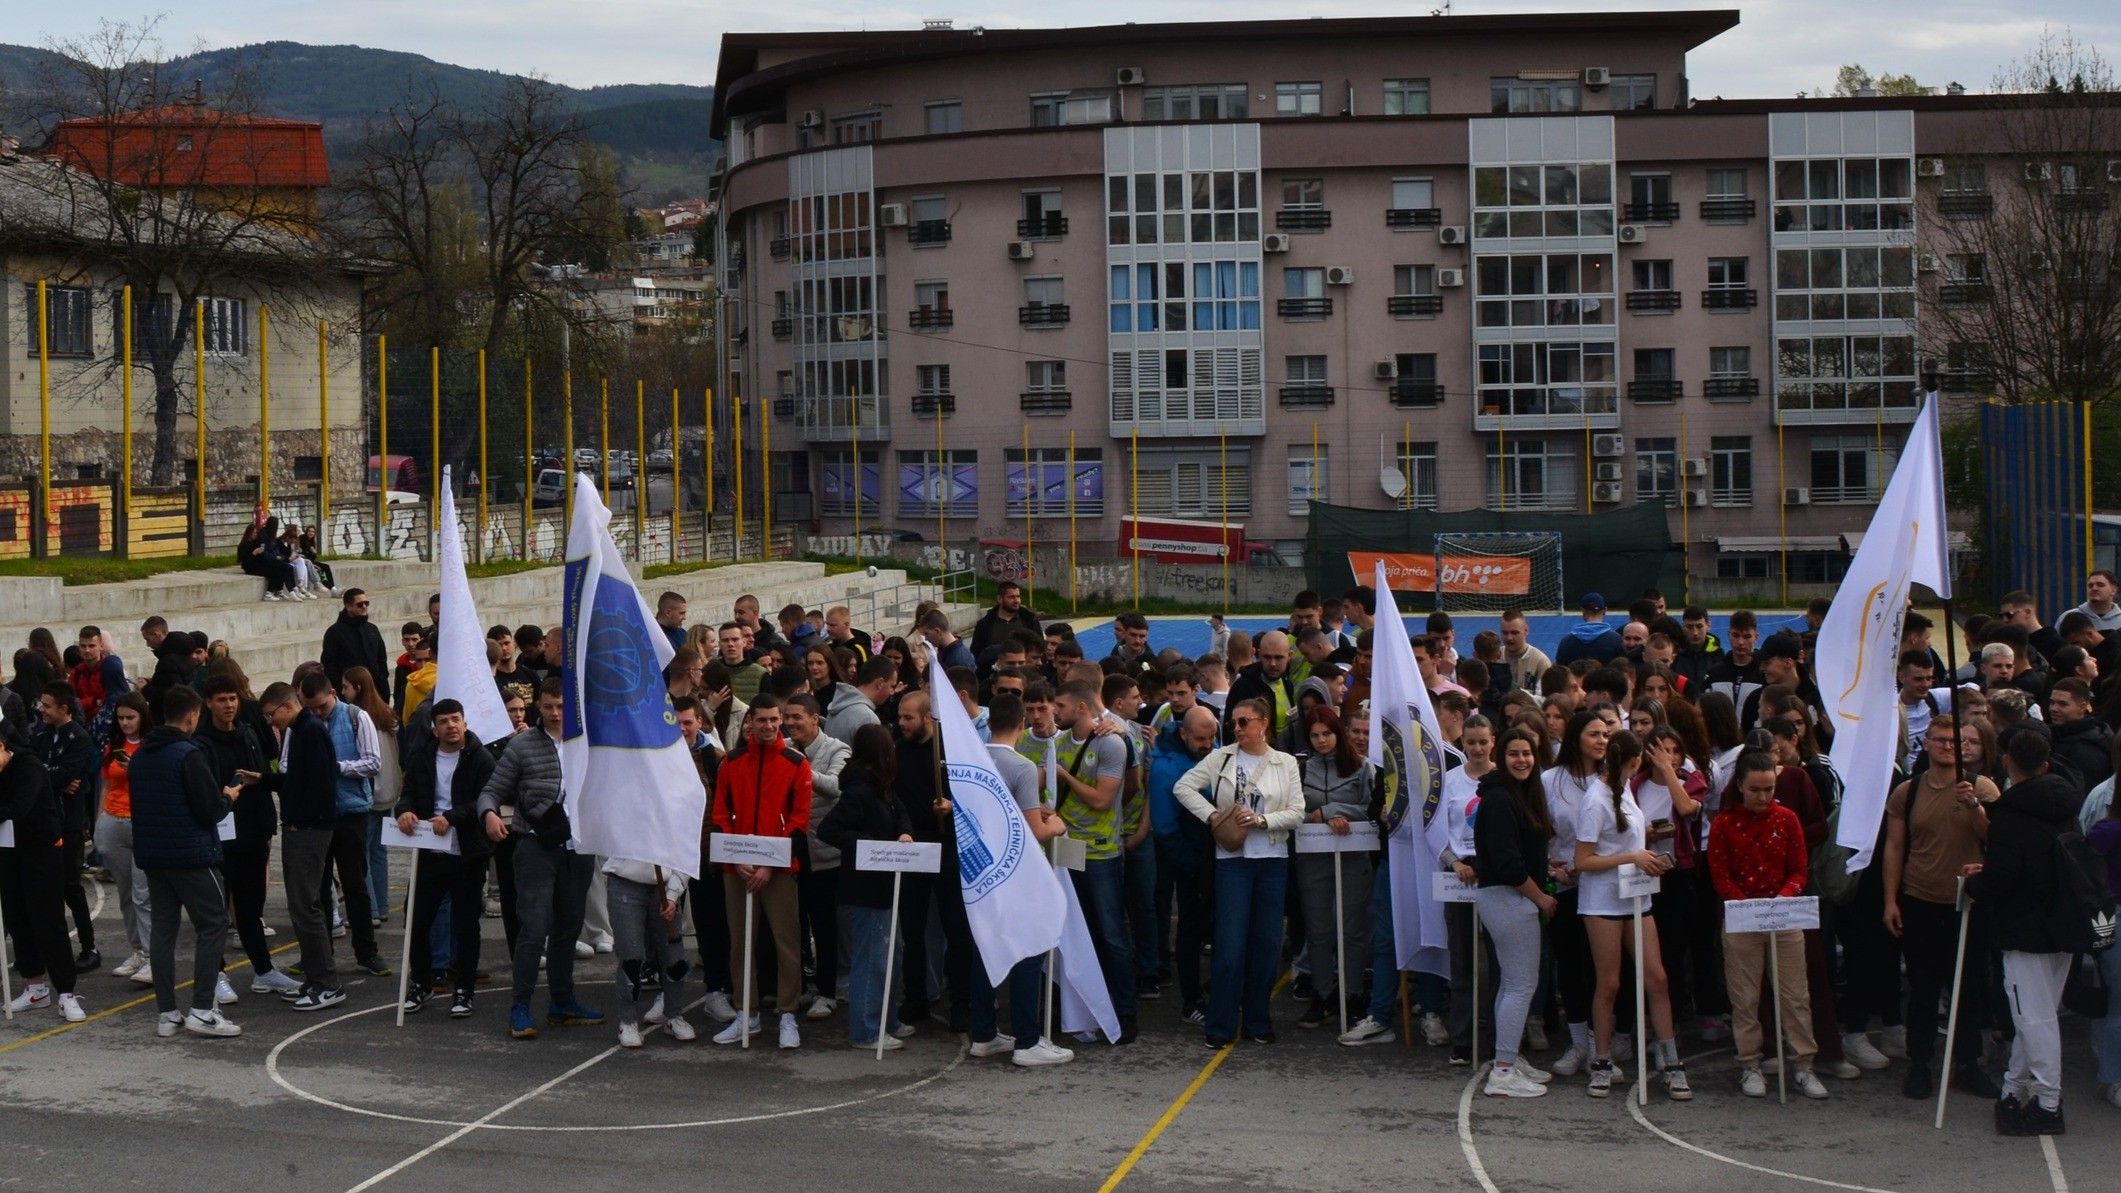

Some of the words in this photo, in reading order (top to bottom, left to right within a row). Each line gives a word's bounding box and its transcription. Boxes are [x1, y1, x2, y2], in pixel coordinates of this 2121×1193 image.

[1385, 566, 1400, 577] oja
[974, 771, 1014, 814] MAŠINSKA
[1003, 815, 1021, 870] TEHNIČKA
[976, 868, 1007, 894] ŠKOLA
